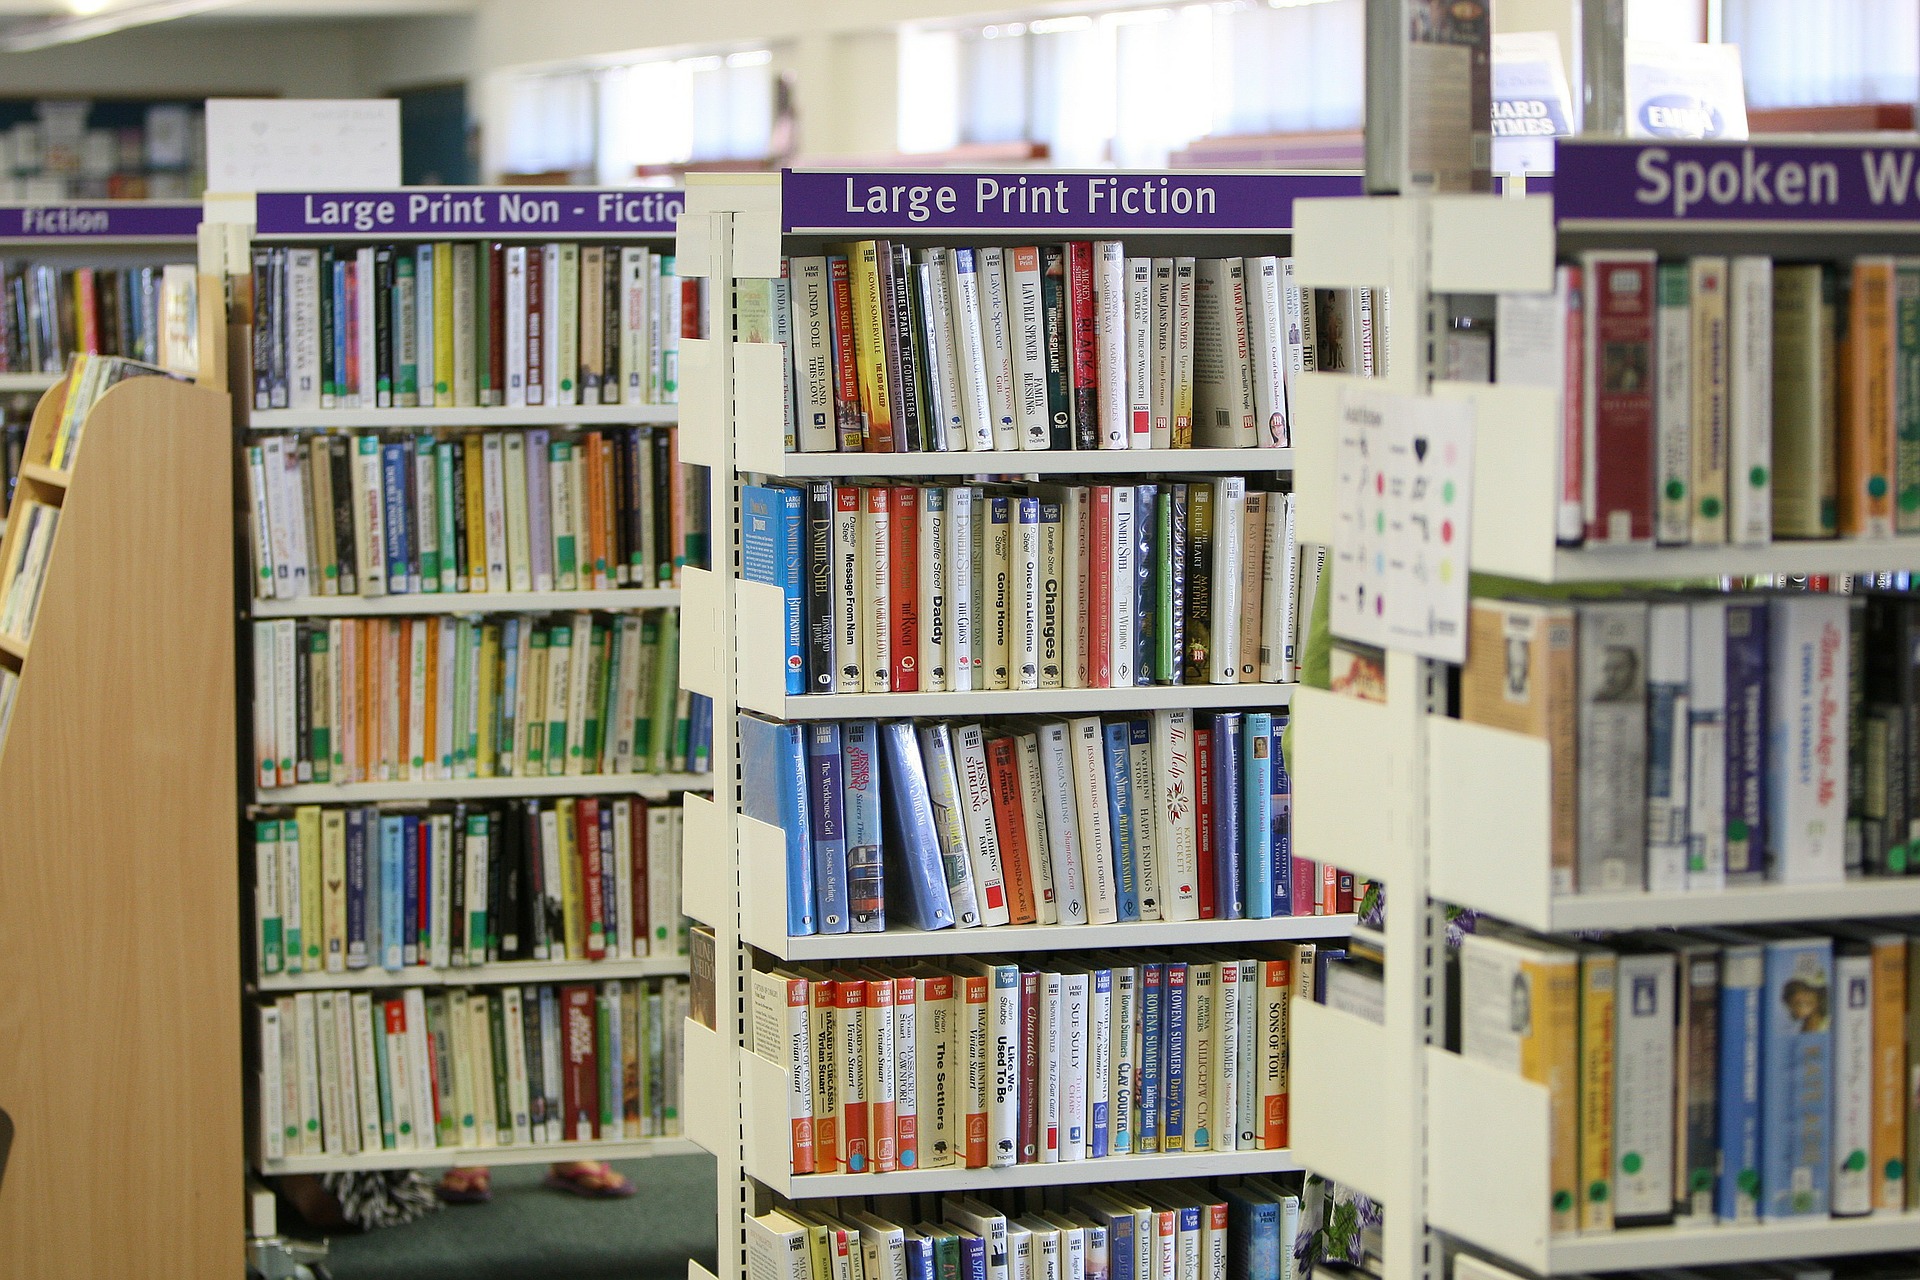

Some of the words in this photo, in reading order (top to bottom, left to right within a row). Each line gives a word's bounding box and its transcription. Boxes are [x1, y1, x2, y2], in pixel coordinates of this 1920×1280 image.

[1635, 148, 1839, 217] Spoken
[304, 195, 395, 231] Large
[408, 194, 485, 223] Print
[500, 195, 559, 223] Non
[845, 177, 957, 222] Large
[976, 176, 1070, 214] Print
[1088, 177, 1216, 214] Fiction
[22, 207, 109, 234] Fiction
[777, 284, 785, 310] LINDA
[838, 284, 848, 308] LINDA
[896, 278, 905, 308] MURIEL
[989, 273, 1001, 309] LaVyrle
[1082, 269, 1090, 301] MICKEY
[808, 284, 817, 318] LINDA
[810, 321, 819, 348] SOLE
[841, 311, 849, 329] SOLE
[899, 311, 908, 338] SPARK
[991, 312, 1003, 350] Spencer
[1048, 308, 1058, 335] MICKEY
[842, 334, 850, 346] The
[902, 346, 910, 360] THE
[1362, 319, 1372, 372] DANIELLE
[843, 348, 851, 363] Ties
[1050, 338, 1059, 373] SPILLANE
[844, 364, 852, 379] That
[810, 380, 818, 405] LOVE
[845, 381, 854, 397] Bind
[903, 365, 915, 417] COMFORTERS
[1023, 373, 1035, 415] BLESSINGS
[1034, 378, 1043, 407] FAMILY
[812, 519, 830, 563] DANIELLE
[842, 522, 850, 542] Steel
[932, 518, 942, 559] Danielle
[1023, 533, 1031, 552] Steel
[1194, 536, 1202, 568] HEART
[813, 564, 831, 596] STEEL
[844, 554, 854, 596] Message
[933, 562, 942, 589] Steel
[996, 572, 1005, 608] Going
[1026, 562, 1034, 589] Once
[846, 598, 855, 622] From
[1027, 591, 1034, 600] in
[1079, 574, 1087, 623] Danielle
[1192, 574, 1201, 619] STEPHEN
[1200, 576, 1208, 617] MARTIN
[812, 623, 823, 644] HOME
[931, 596, 943, 645] Daddy
[997, 611, 1005, 646] Home
[1026, 610, 1034, 652] Lifetime
[1043, 579, 1058, 659] Changes
[847, 624, 855, 645] Nam
[1053, 748, 1065, 780] JESSICA
[1135, 762, 1143, 790] STONE
[1141, 750, 1150, 800] KATHERINE
[966, 756, 980, 812] STIRLING
[976, 759, 990, 805] JESSICA
[856, 793, 864, 820] Sisters
[1058, 782, 1070, 823] STIRLING
[856, 822, 864, 844] Three
[984, 816, 992, 836] THE
[1140, 808, 1150, 841] HAPPY
[979, 836, 987, 856] FAIR
[987, 838, 997, 872] HIRING
[1064, 830, 1073, 866] Shamrock
[1067, 868, 1076, 890] Green
[1143, 845, 1153, 892] ENDINGS
[999, 997, 1007, 1025] Stubbs
[1071, 1003, 1080, 1028] SUE
[1121, 995, 1130, 1023] Rowena
[1146, 994, 1158, 1032] ROWENA
[1171, 990, 1182, 1027] ROWENA
[1224, 988, 1234, 1032] ROWENA
[1269, 1003, 1280, 1033] SONS
[846, 1023, 855, 1054] Vivian
[899, 1013, 907, 1039] Stuart
[978, 1008, 986, 1047] HAZARD
[793, 1033, 801, 1061] Vivian
[818, 1031, 826, 1062] Vivian
[877, 1028, 885, 1056] Vivian
[937, 1042, 945, 1069] The
[969, 1029, 978, 1058] Vivian
[978, 1049, 986, 1059] OF
[996, 1036, 1007, 1066] Used
[1071, 1032, 1080, 1070] SULLY
[1120, 1025, 1129, 1058] Summers
[1170, 1031, 1181, 1075] SUMMERS
[1269, 1035, 1279, 1051] OF
[1007, 1046, 1015, 1070] Like
[1095, 1043, 1103, 1079] Summers
[1145, 1036, 1157, 1079] SUMMERS
[1224, 1035, 1234, 1079] SUMMERS
[1269, 1053, 1280, 1081] TOIL
[794, 1065, 802, 1093] Stuart
[819, 1064, 827, 1095] Stuart
[847, 1057, 856, 1088] Stuart
[969, 1061, 977, 1090] Stuart
[977, 1061, 986, 1108] HUNTRESS
[996, 1069, 1006, 1084] To
[1007, 1073, 1015, 1092] We
[1118, 1063, 1131, 1086] CLAY
[936, 1073, 946, 1130] Settlers
[996, 1087, 1006, 1103] Be
[1143, 1084, 1157, 1108] Taking
[1170, 1078, 1181, 1107] Daisy's
[1145, 1110, 1156, 1129] Heart
[1170, 1109, 1179, 1124] War
[1163, 1242, 1171, 1277] LESLIE
